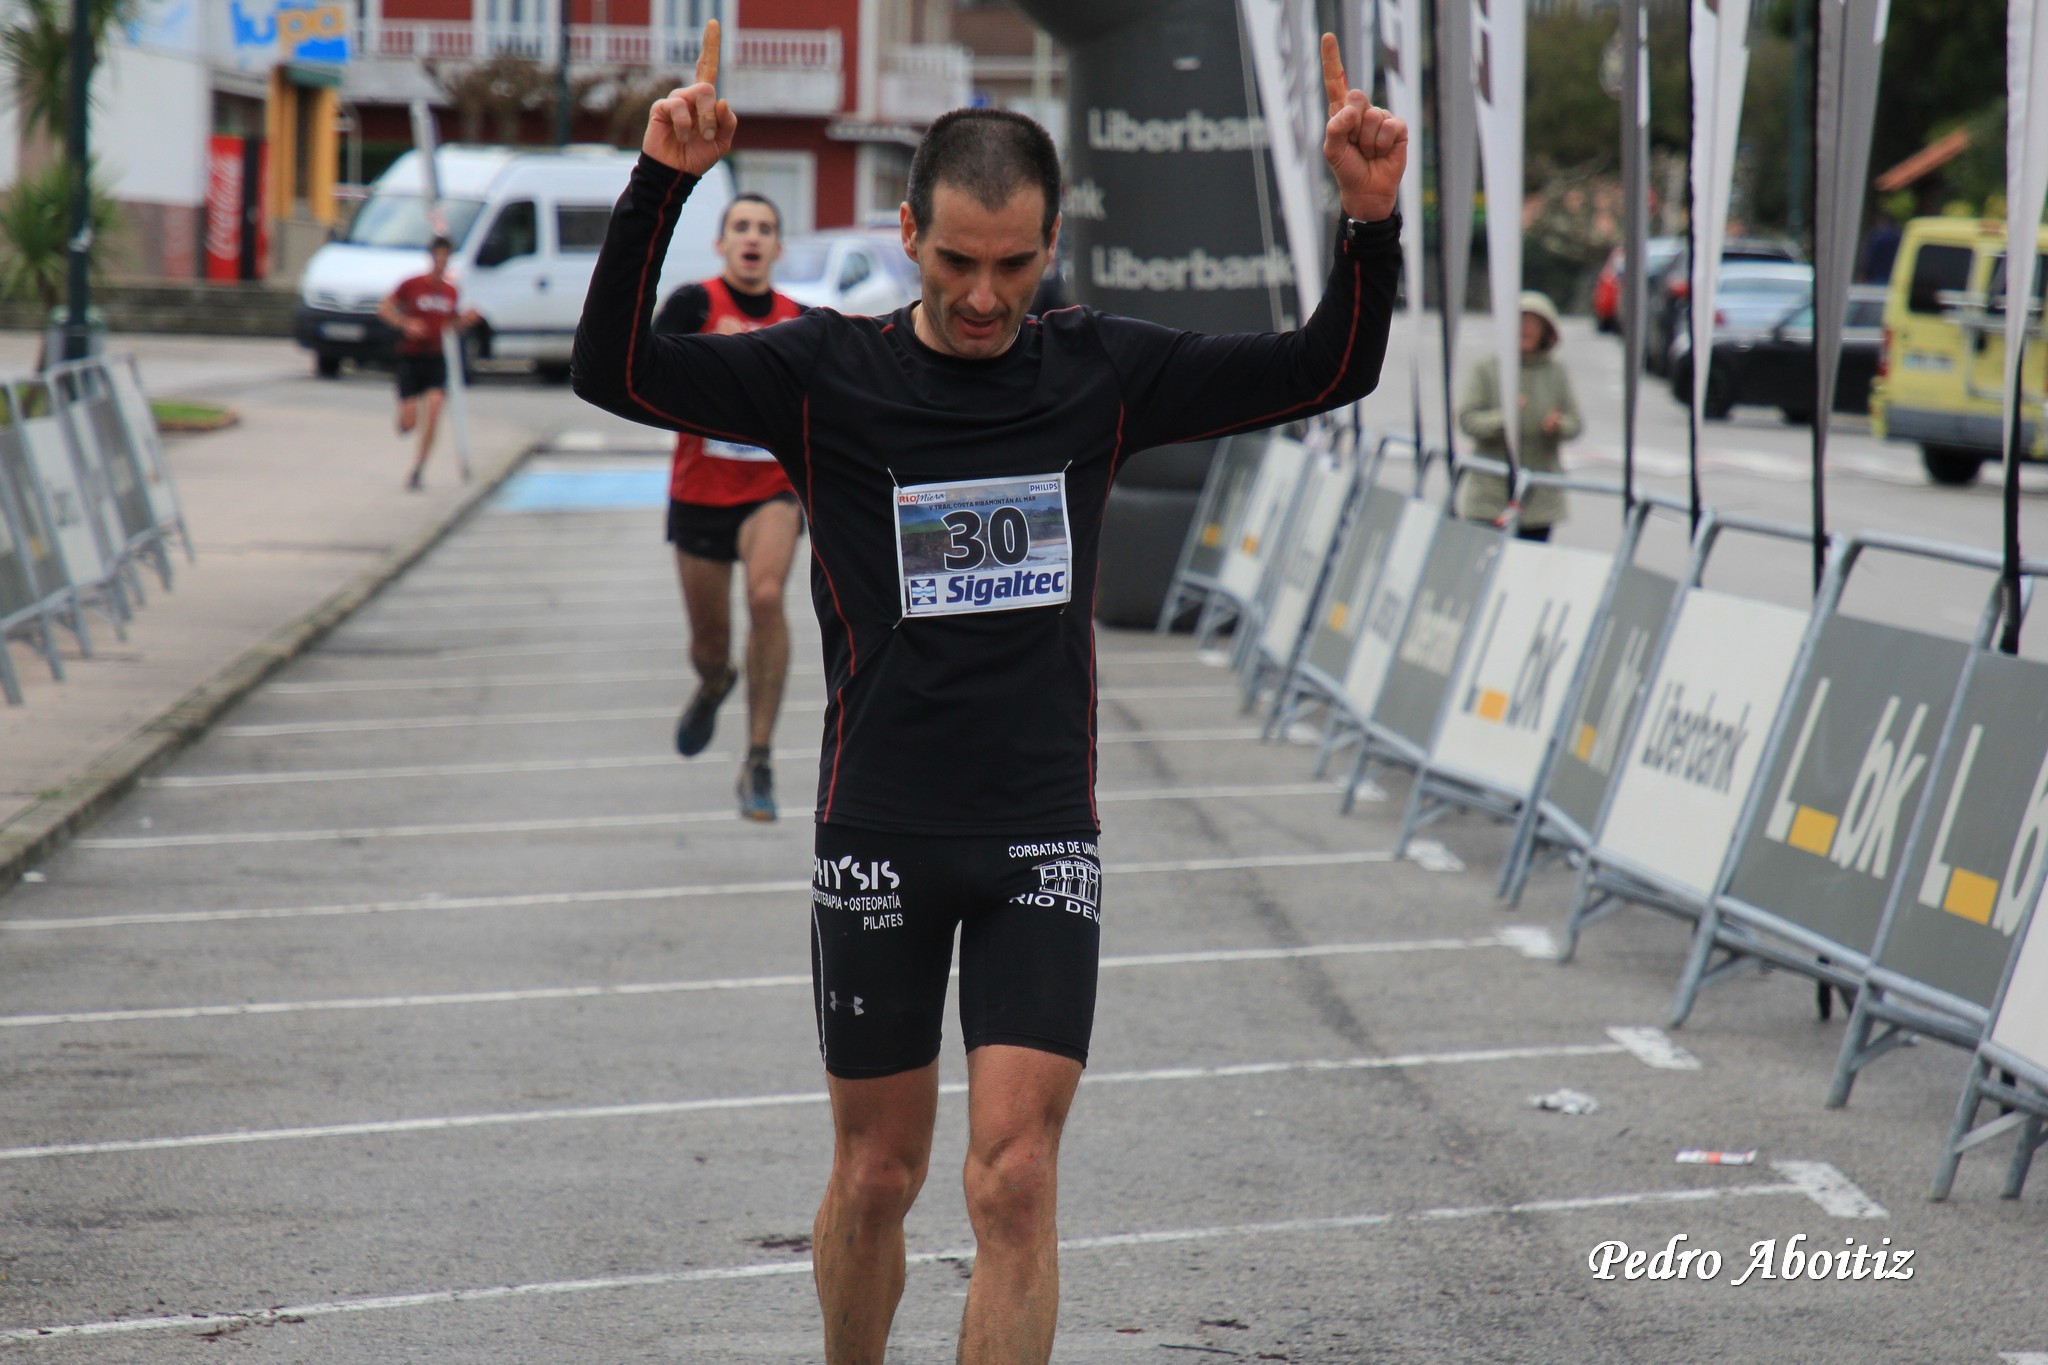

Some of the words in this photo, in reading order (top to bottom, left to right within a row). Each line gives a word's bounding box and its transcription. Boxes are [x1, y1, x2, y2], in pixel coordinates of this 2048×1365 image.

[1088, 109, 1270, 152] Liberban
[1030, 483, 1058, 492] PHILIPS
[953, 500, 974, 509] COSTA
[941, 505, 1030, 571] 30
[946, 571, 1065, 606] Sigaltec
[1639, 681, 1751, 796] Liberbank
[1008, 842, 1065, 858] CORBATAS
[1067, 841, 1080, 854] DE
[849, 892, 902, 911] OSTEOPATÍA
[1065, 900, 1100, 924] DEV
[863, 914, 904, 931] PILATES
